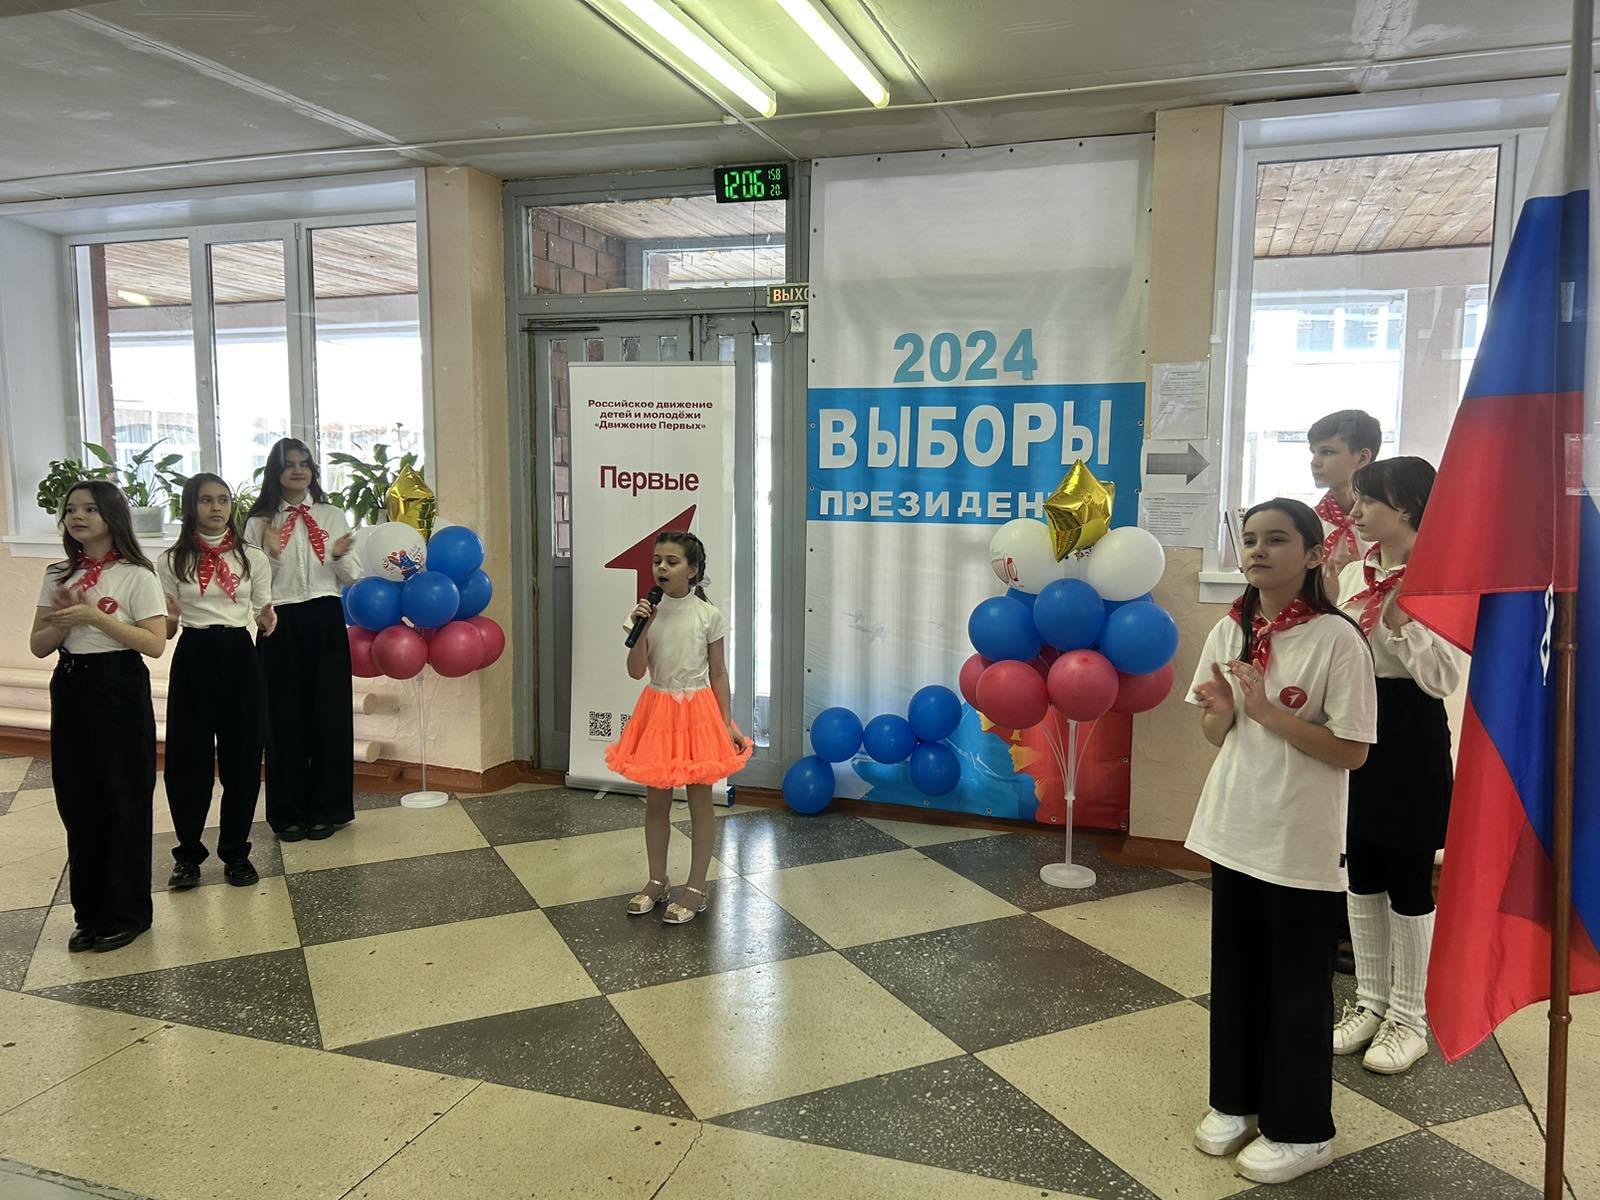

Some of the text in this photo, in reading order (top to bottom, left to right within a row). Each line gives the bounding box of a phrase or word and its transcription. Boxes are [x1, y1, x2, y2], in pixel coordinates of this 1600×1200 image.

[893, 328, 1038, 383] 2024
[588, 399, 713, 410] Российское движение
[600, 410, 632, 419] детей
[643, 411, 701, 420] молодёжи
[594, 420, 706, 431] «Движение Первых»
[819, 399, 1112, 469] ВЫБОРЫ
[600, 465, 699, 496] Первые
[819, 490, 1052, 519] ПРЕЗИДЕН
